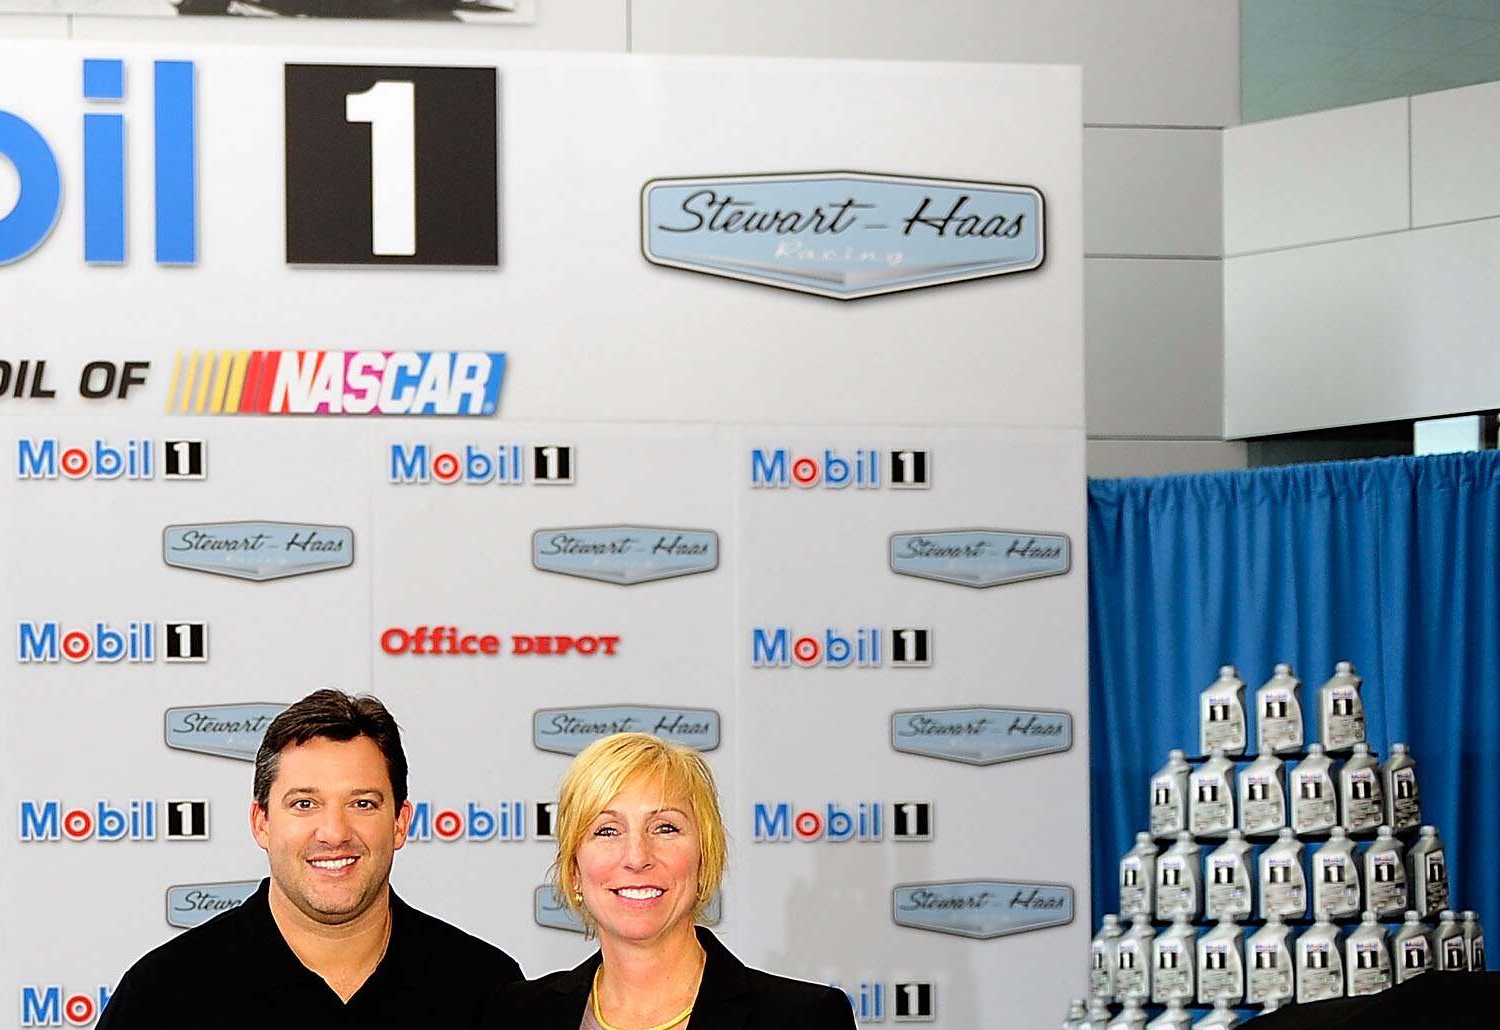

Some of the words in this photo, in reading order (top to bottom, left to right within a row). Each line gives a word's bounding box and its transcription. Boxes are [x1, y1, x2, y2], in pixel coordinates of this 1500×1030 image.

[659, 191, 875, 234] Stewart
[905, 195, 1025, 239] Haas
[774, 241, 907, 266] Racing
[79, 361, 150, 399] OF
[269, 350, 493, 414] NASCAR
[19, 439, 150, 476] Mobil
[391, 444, 520, 481] Mobil
[751, 448, 877, 485] Mobil
[171, 530, 271, 551] Stewart
[285, 532, 343, 552] Haas
[20, 623, 152, 660] Mobil
[381, 626, 500, 655] Office
[513, 636, 620, 655] DEPOT
[753, 628, 879, 664] Mobil
[172, 712, 273, 733] Stewart
[21, 801, 153, 838] Mobil
[754, 803, 881, 838] Mobil
